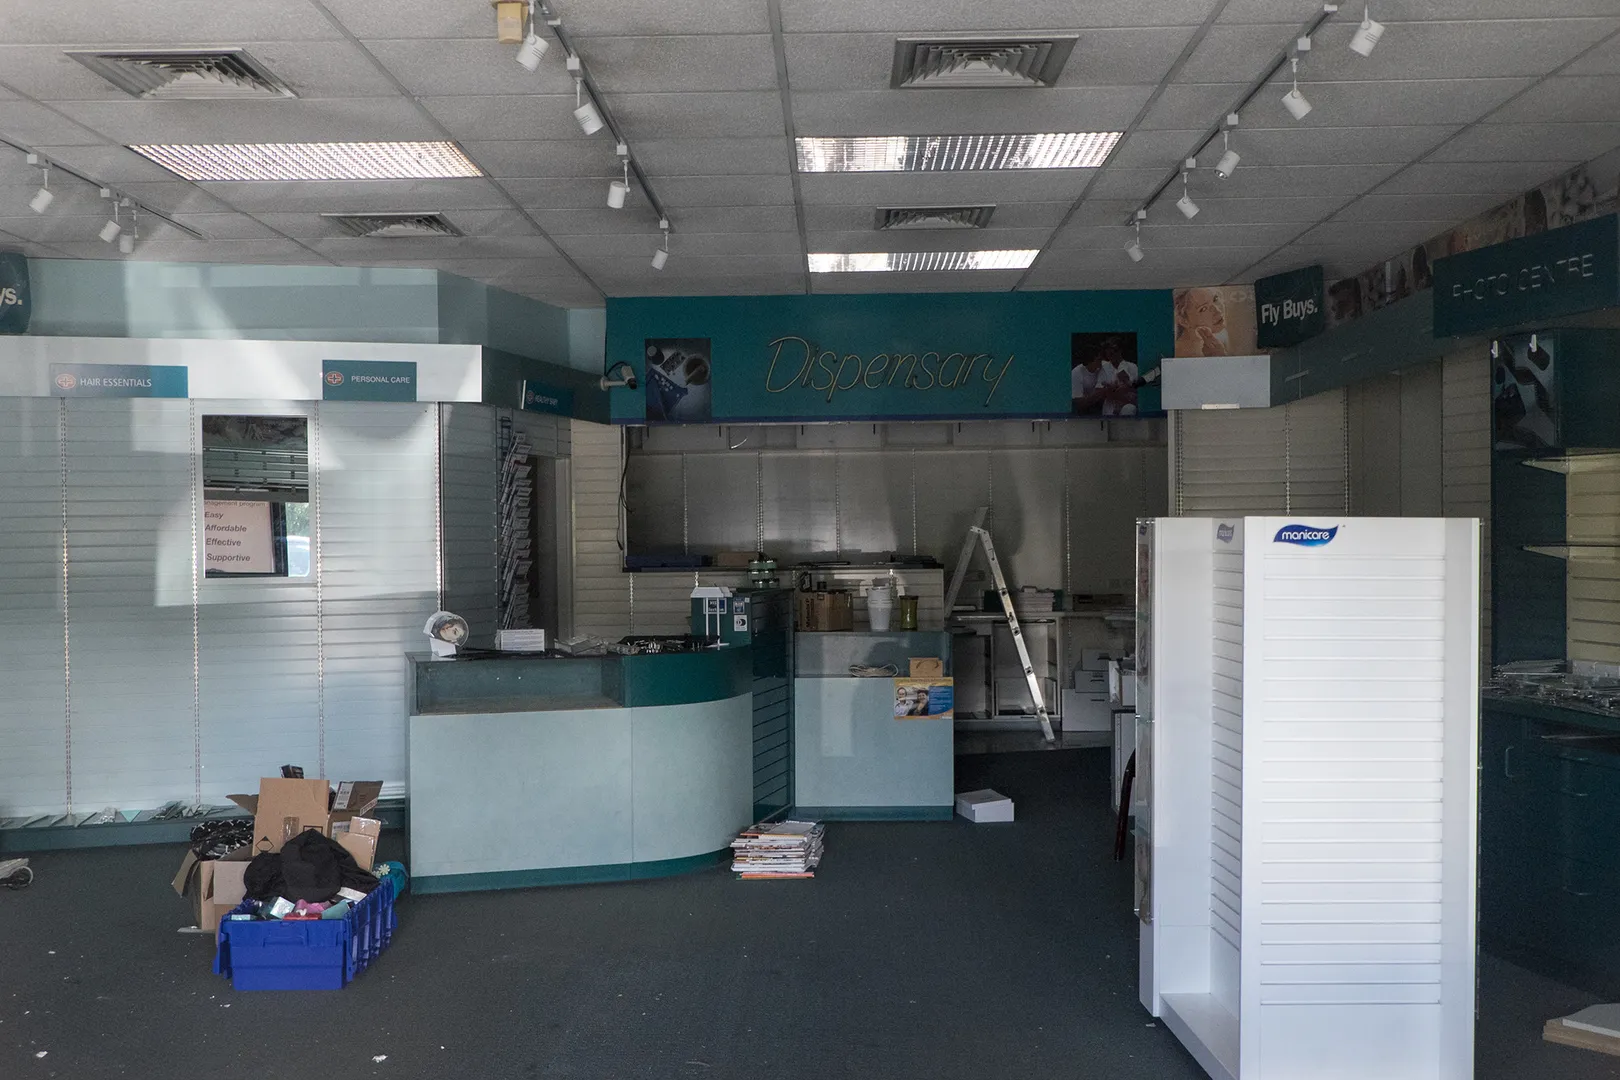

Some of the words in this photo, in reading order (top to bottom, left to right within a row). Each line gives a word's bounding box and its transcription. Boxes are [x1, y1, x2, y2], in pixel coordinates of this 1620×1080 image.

[1517, 254, 1594, 291] CENTRE
[1261, 303, 1280, 326] Fly
[1283, 299, 1318, 320] Buys.
[766, 336, 1015, 407] Dispensary
[80, 377, 101, 387] HAIR
[103, 378, 152, 388] ESSENTIALS
[351, 375, 389, 383] PERSONAL
[390, 376, 410, 384] CARE
[204, 511, 224, 519] Easy
[205, 524, 247, 532] Affordable
[1281, 529, 1330, 540] manicare
[206, 538, 242, 546] Effective
[206, 553, 251, 562] Supportive
